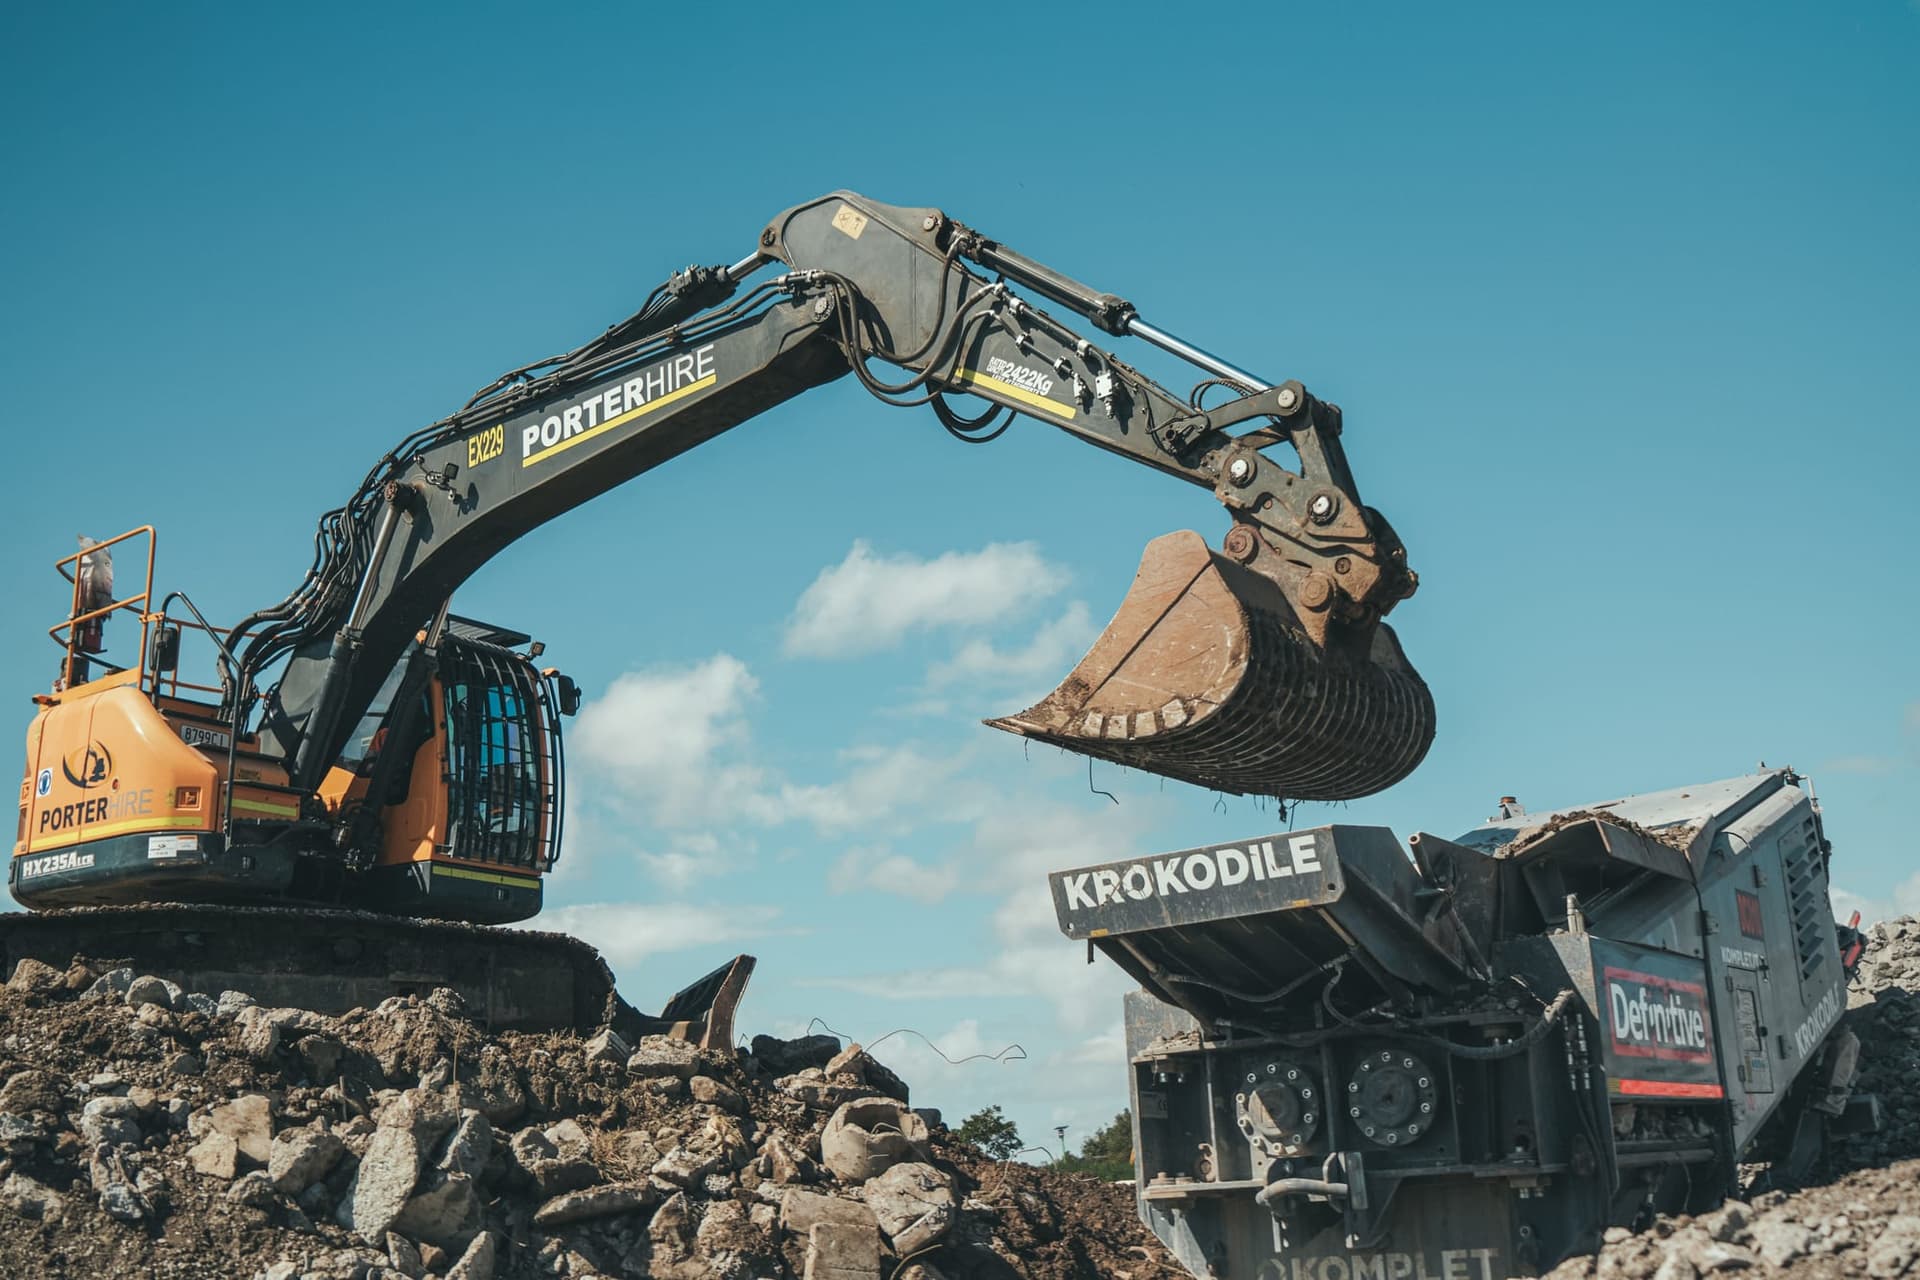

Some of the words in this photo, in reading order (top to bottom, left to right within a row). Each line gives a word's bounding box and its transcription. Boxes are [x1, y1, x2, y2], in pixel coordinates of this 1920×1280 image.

[1002, 362, 1053, 395] 2422Kg
[467, 424, 505, 468] EX229
[1063, 835, 1321, 911] KROKODILE
[1291, 1249, 1499, 1280] KOMPLET
